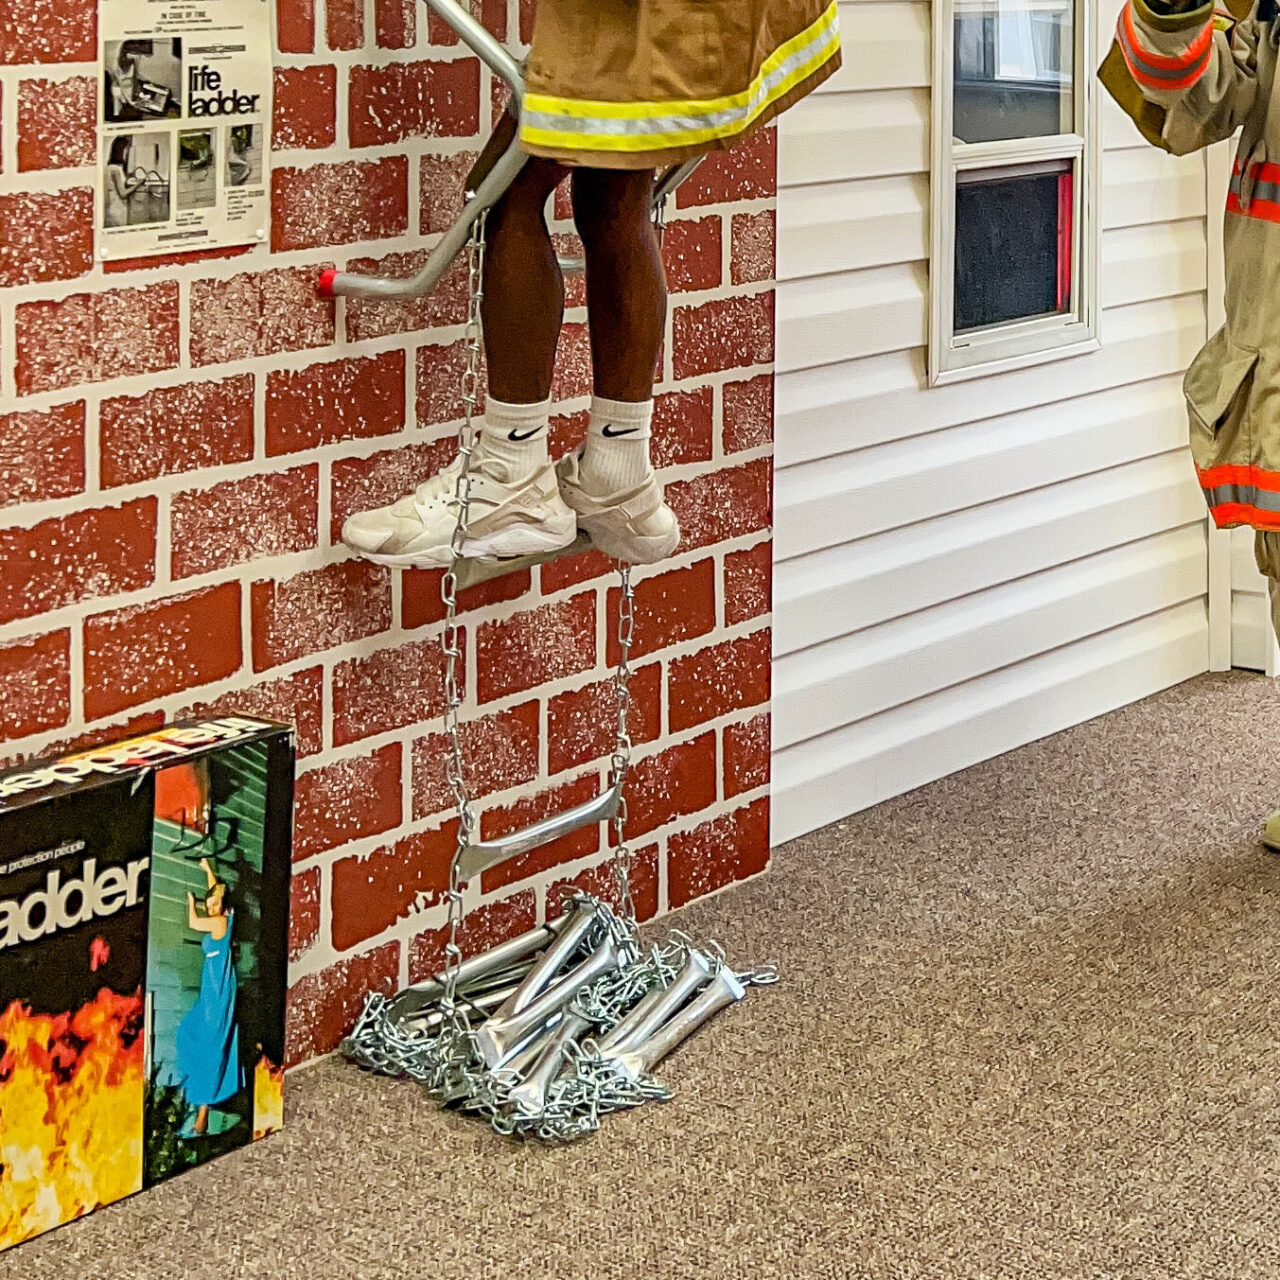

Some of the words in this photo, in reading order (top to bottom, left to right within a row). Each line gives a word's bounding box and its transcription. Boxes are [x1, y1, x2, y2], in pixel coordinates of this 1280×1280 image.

[188, 65, 221, 91] life
[188, 89, 260, 118] ladder
[8, 851, 54, 874] protection
[54, 840, 86, 858] people
[0, 856, 150, 951] adder
